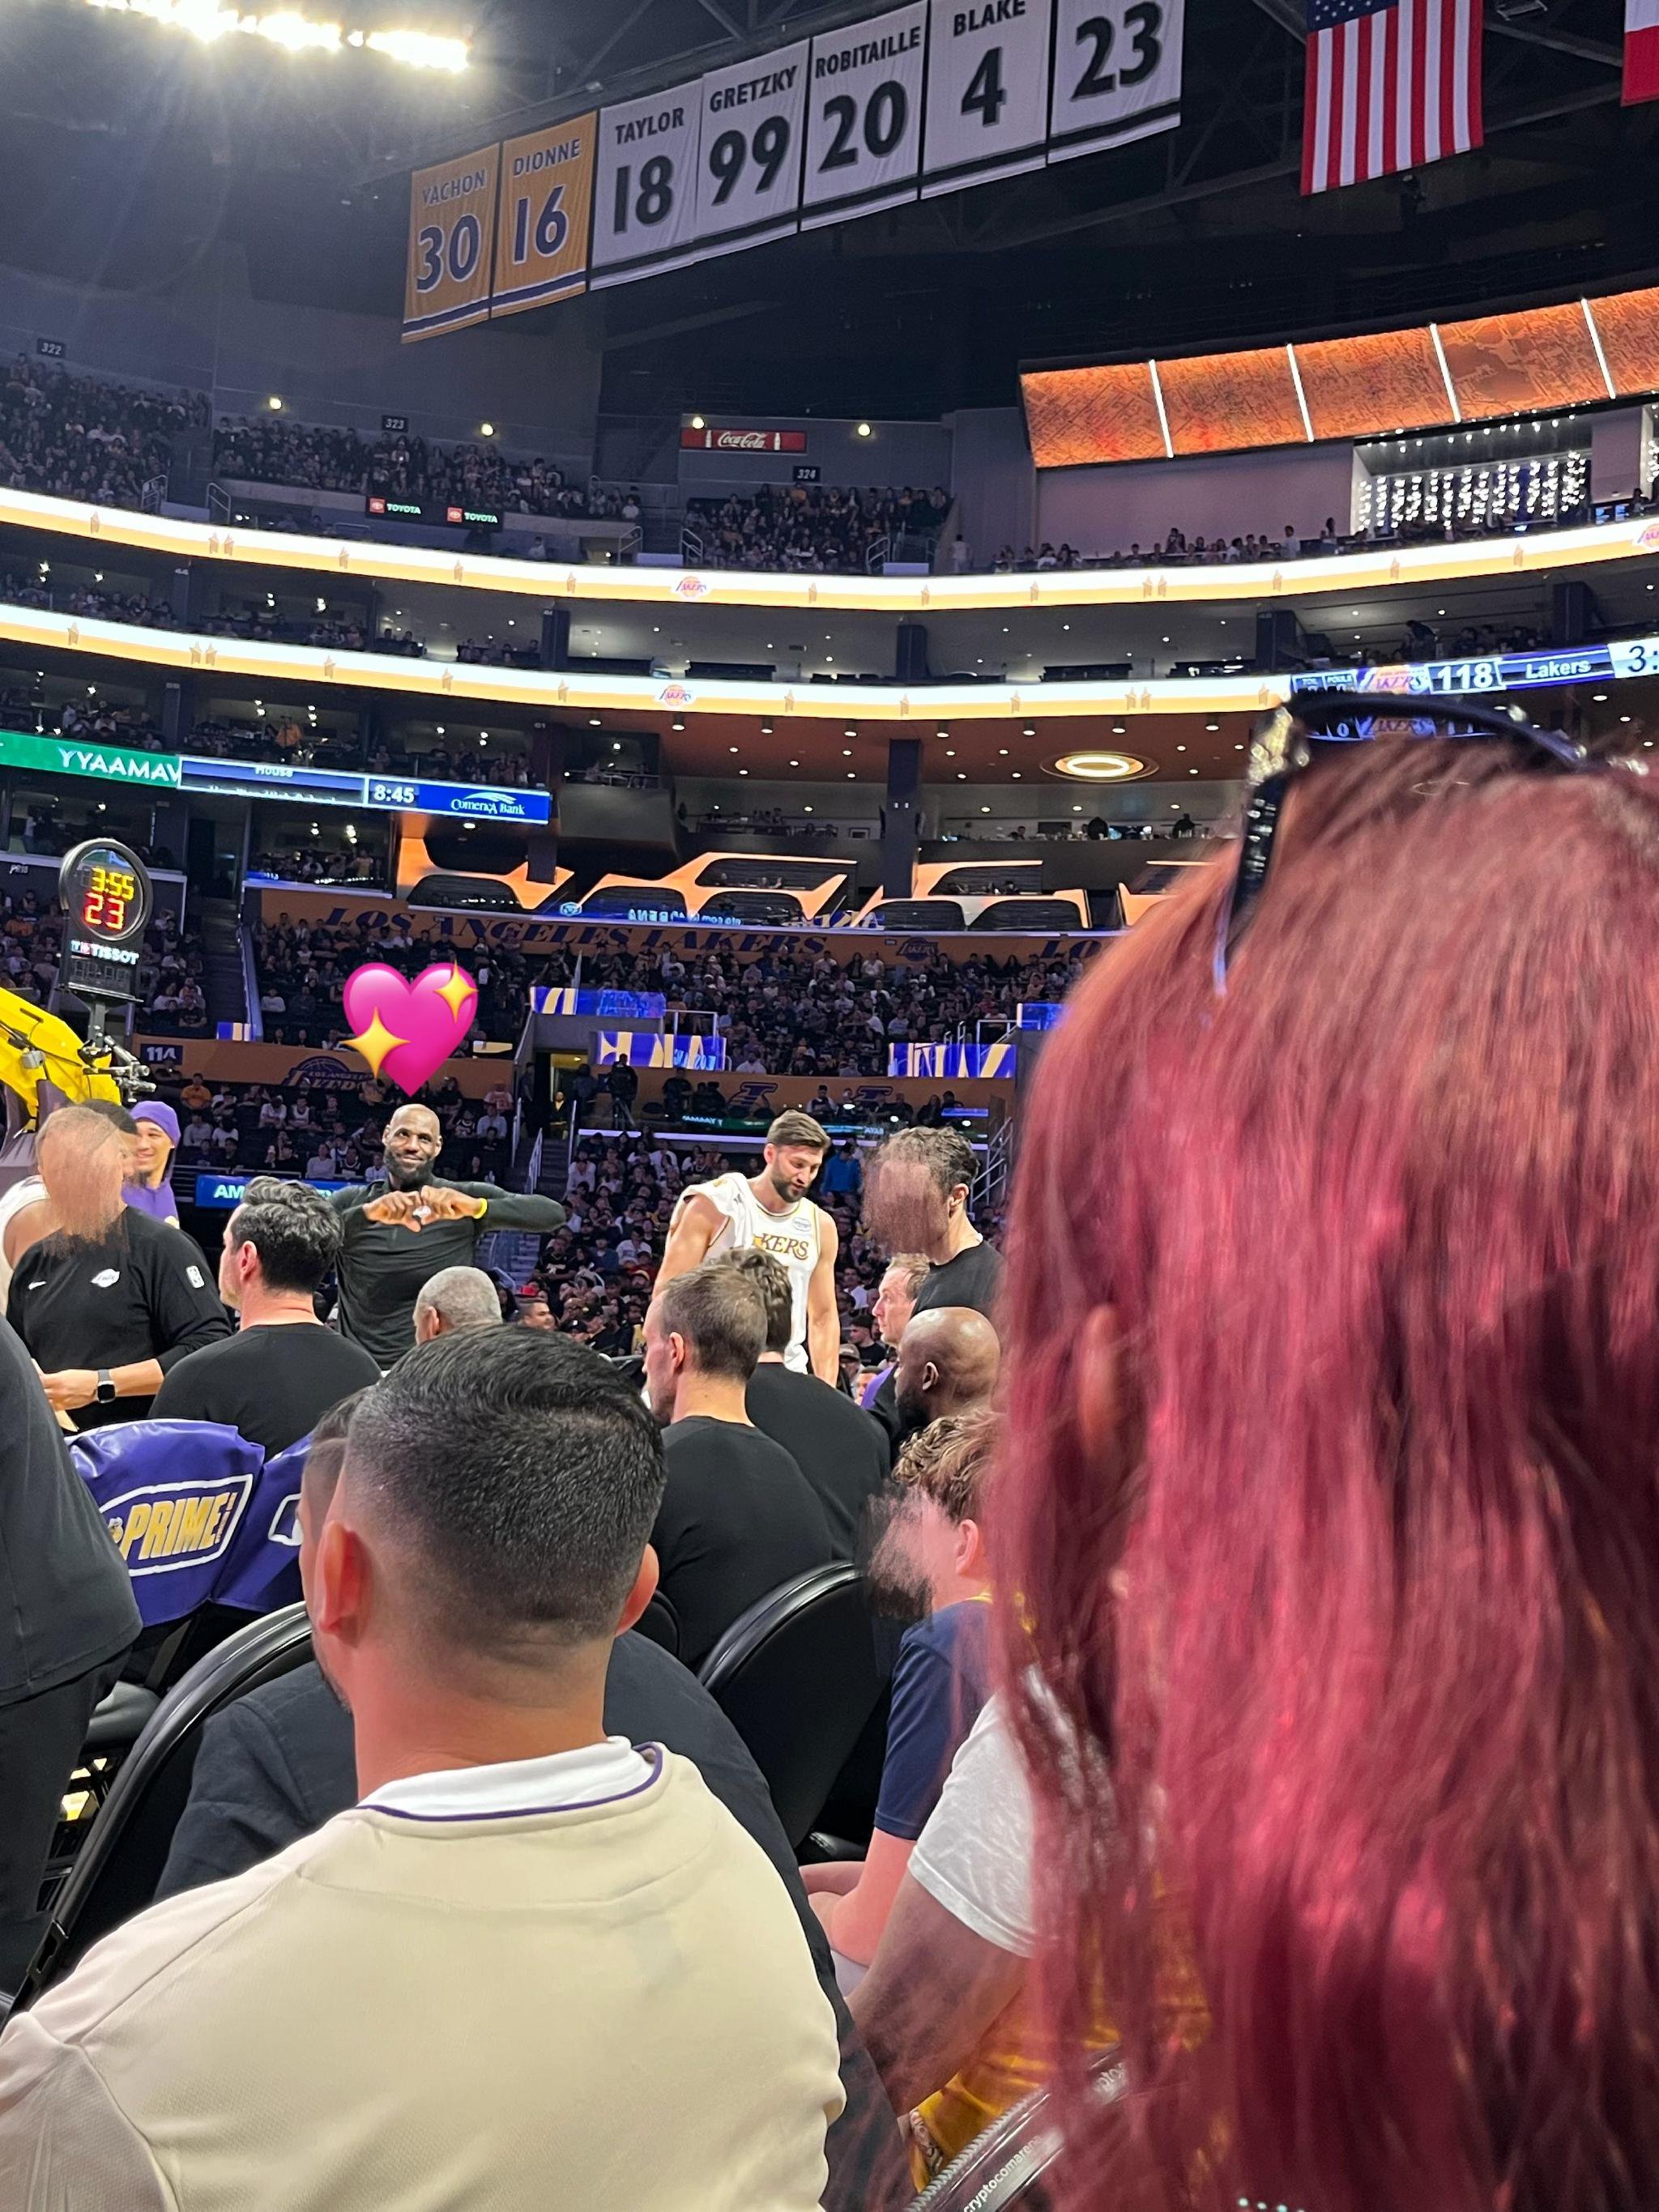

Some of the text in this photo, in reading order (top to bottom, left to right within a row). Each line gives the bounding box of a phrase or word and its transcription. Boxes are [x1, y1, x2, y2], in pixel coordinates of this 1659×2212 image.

[953, 0, 1026, 37] BLAKE
[815, 26, 921, 79] ROBITAILLE
[1070, 2, 1162, 102] 23
[710, 65, 797, 113] GRETZKY
[961, 46, 1006, 127] 4
[615, 108, 684, 145] TAYLOR
[817, 79, 908, 173] 20
[514, 139, 580, 176] DIONNE
[709, 115, 791, 207] 99
[423, 169, 485, 204] VACHON
[613, 155, 674, 234] 18
[513, 185, 569, 265] 16
[416, 214, 481, 292] 30
[41, 342, 62, 355] 322
[386, 418, 404, 429] 323
[797, 469, 817, 479] 324
[386, 503, 421, 514] TOYOTA
[463, 512, 498, 523] TOYOTA
[1437, 662, 1494, 691] 118
[1525, 660, 1592, 680] Lakers
[373, 784, 415, 803] 8:45
[500, 803, 526, 816] Bank
[91, 867, 134, 901] 3:55
[84, 892, 125, 930] 23
[325, 907, 416, 930] LOS
[147, 1046, 177, 1060] 11A
[753, 1233, 809, 1261] KERS
